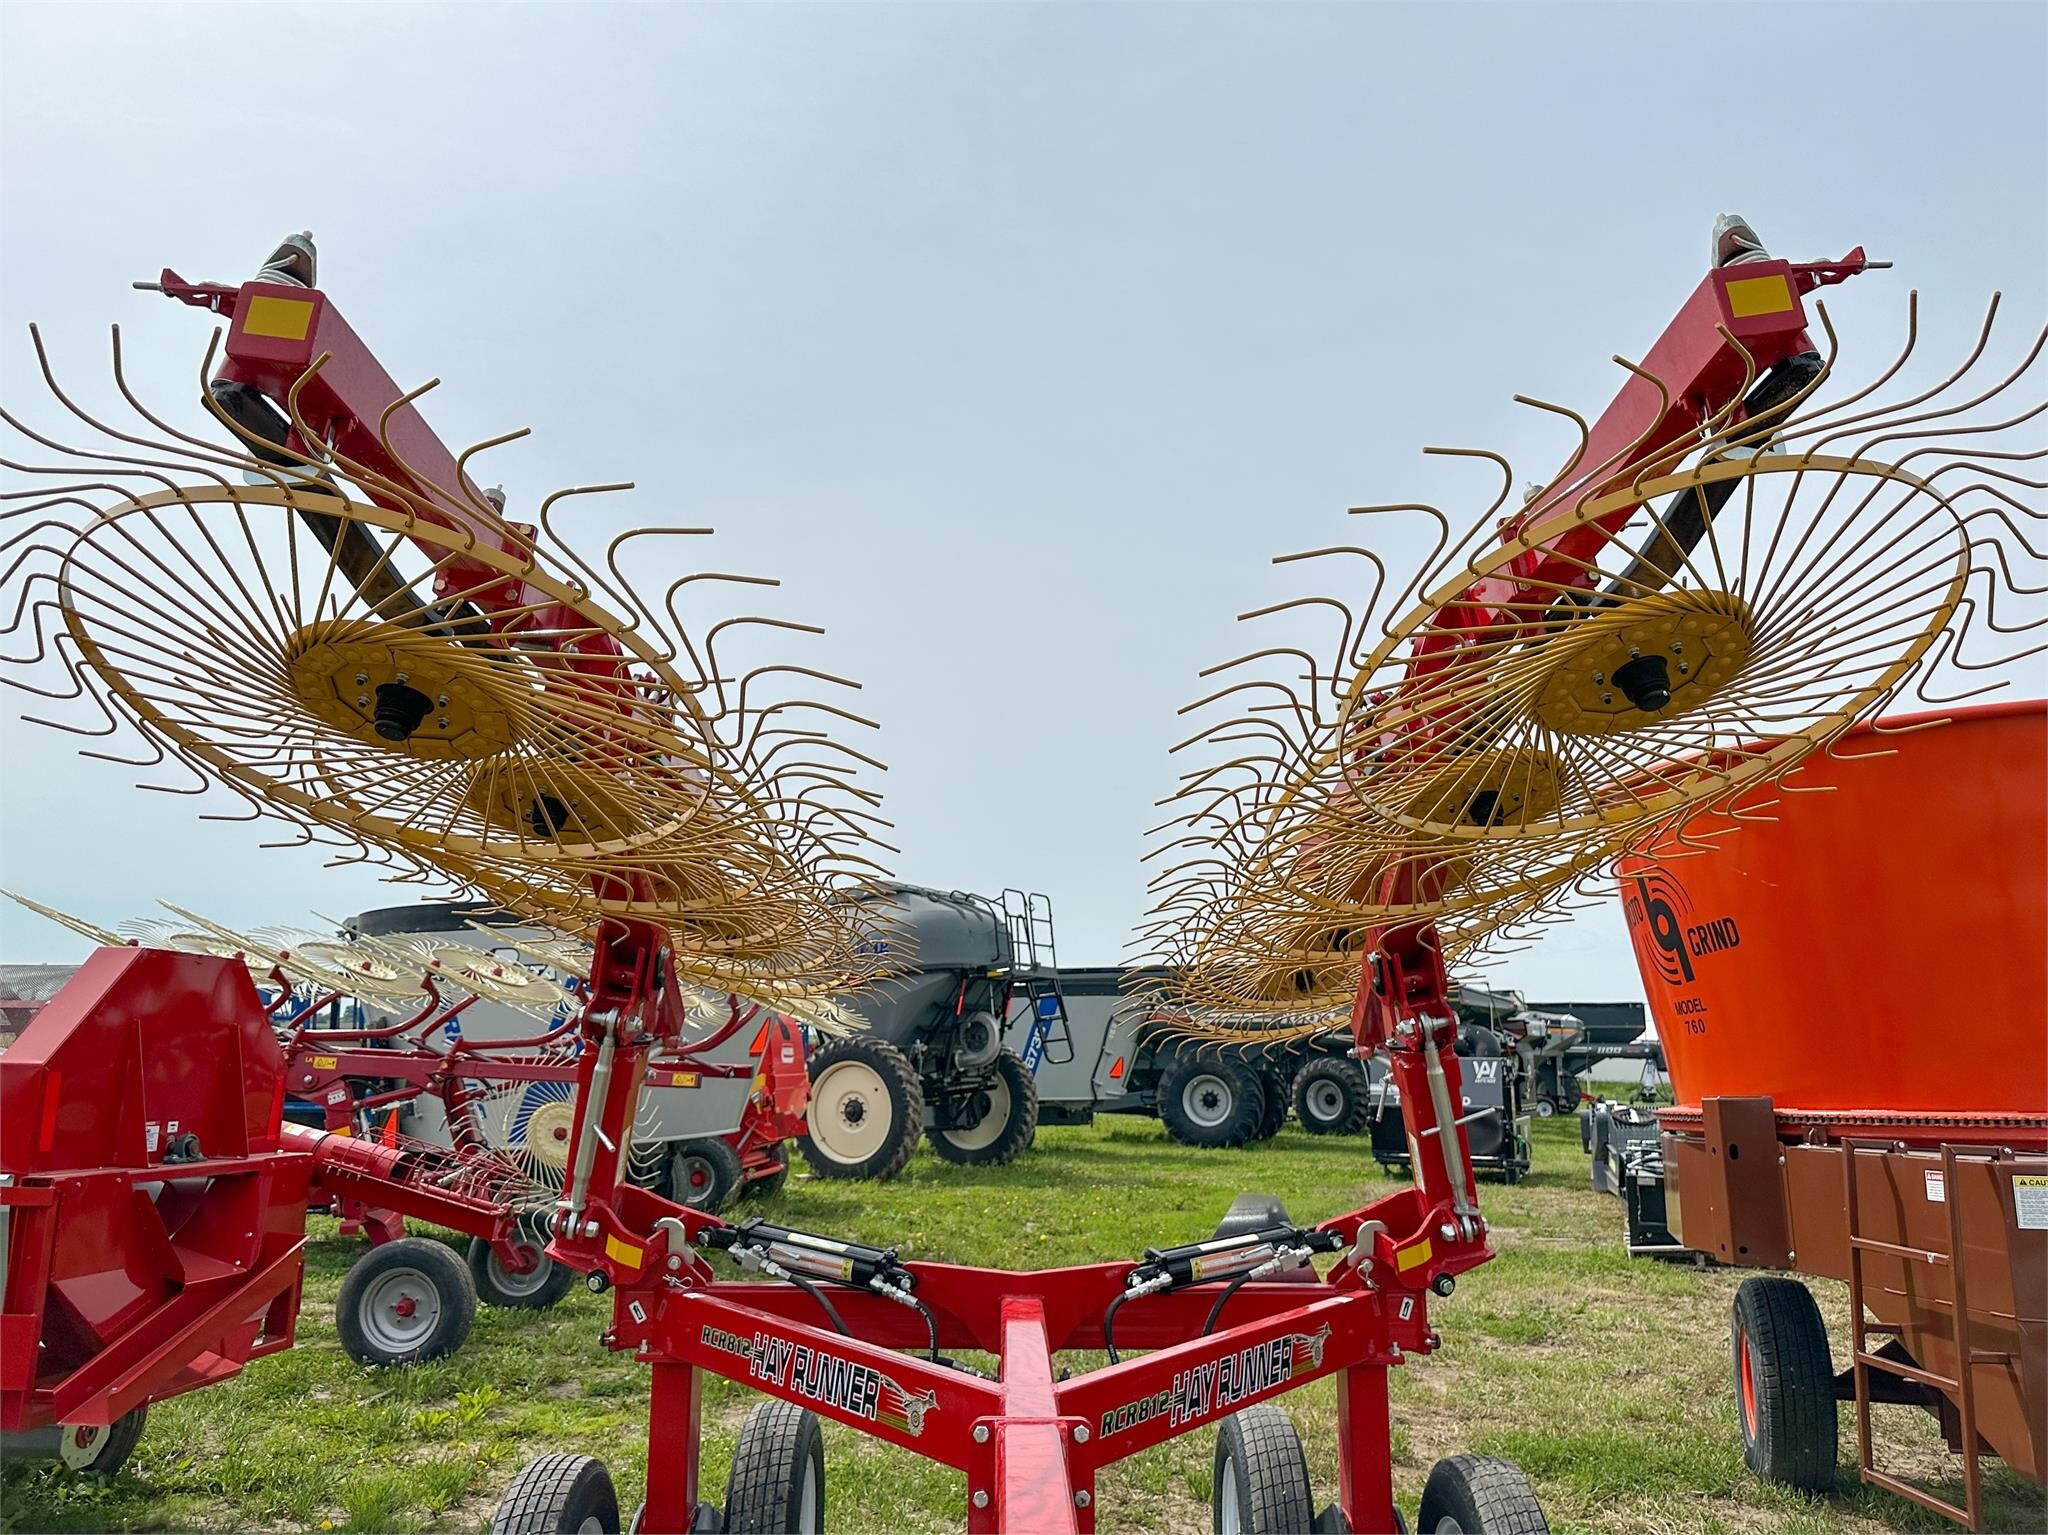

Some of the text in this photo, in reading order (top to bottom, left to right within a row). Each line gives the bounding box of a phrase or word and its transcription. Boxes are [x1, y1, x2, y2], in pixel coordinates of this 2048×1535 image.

[1687, 917, 1740, 957] GRIND
[1675, 998, 1707, 1016] MODEL
[1685, 1019, 1706, 1035] 760
[701, 1325, 881, 1421] RCR812 HAY RUNNER
[1100, 1334, 1295, 1439] RCR812 HAY RUNNER
